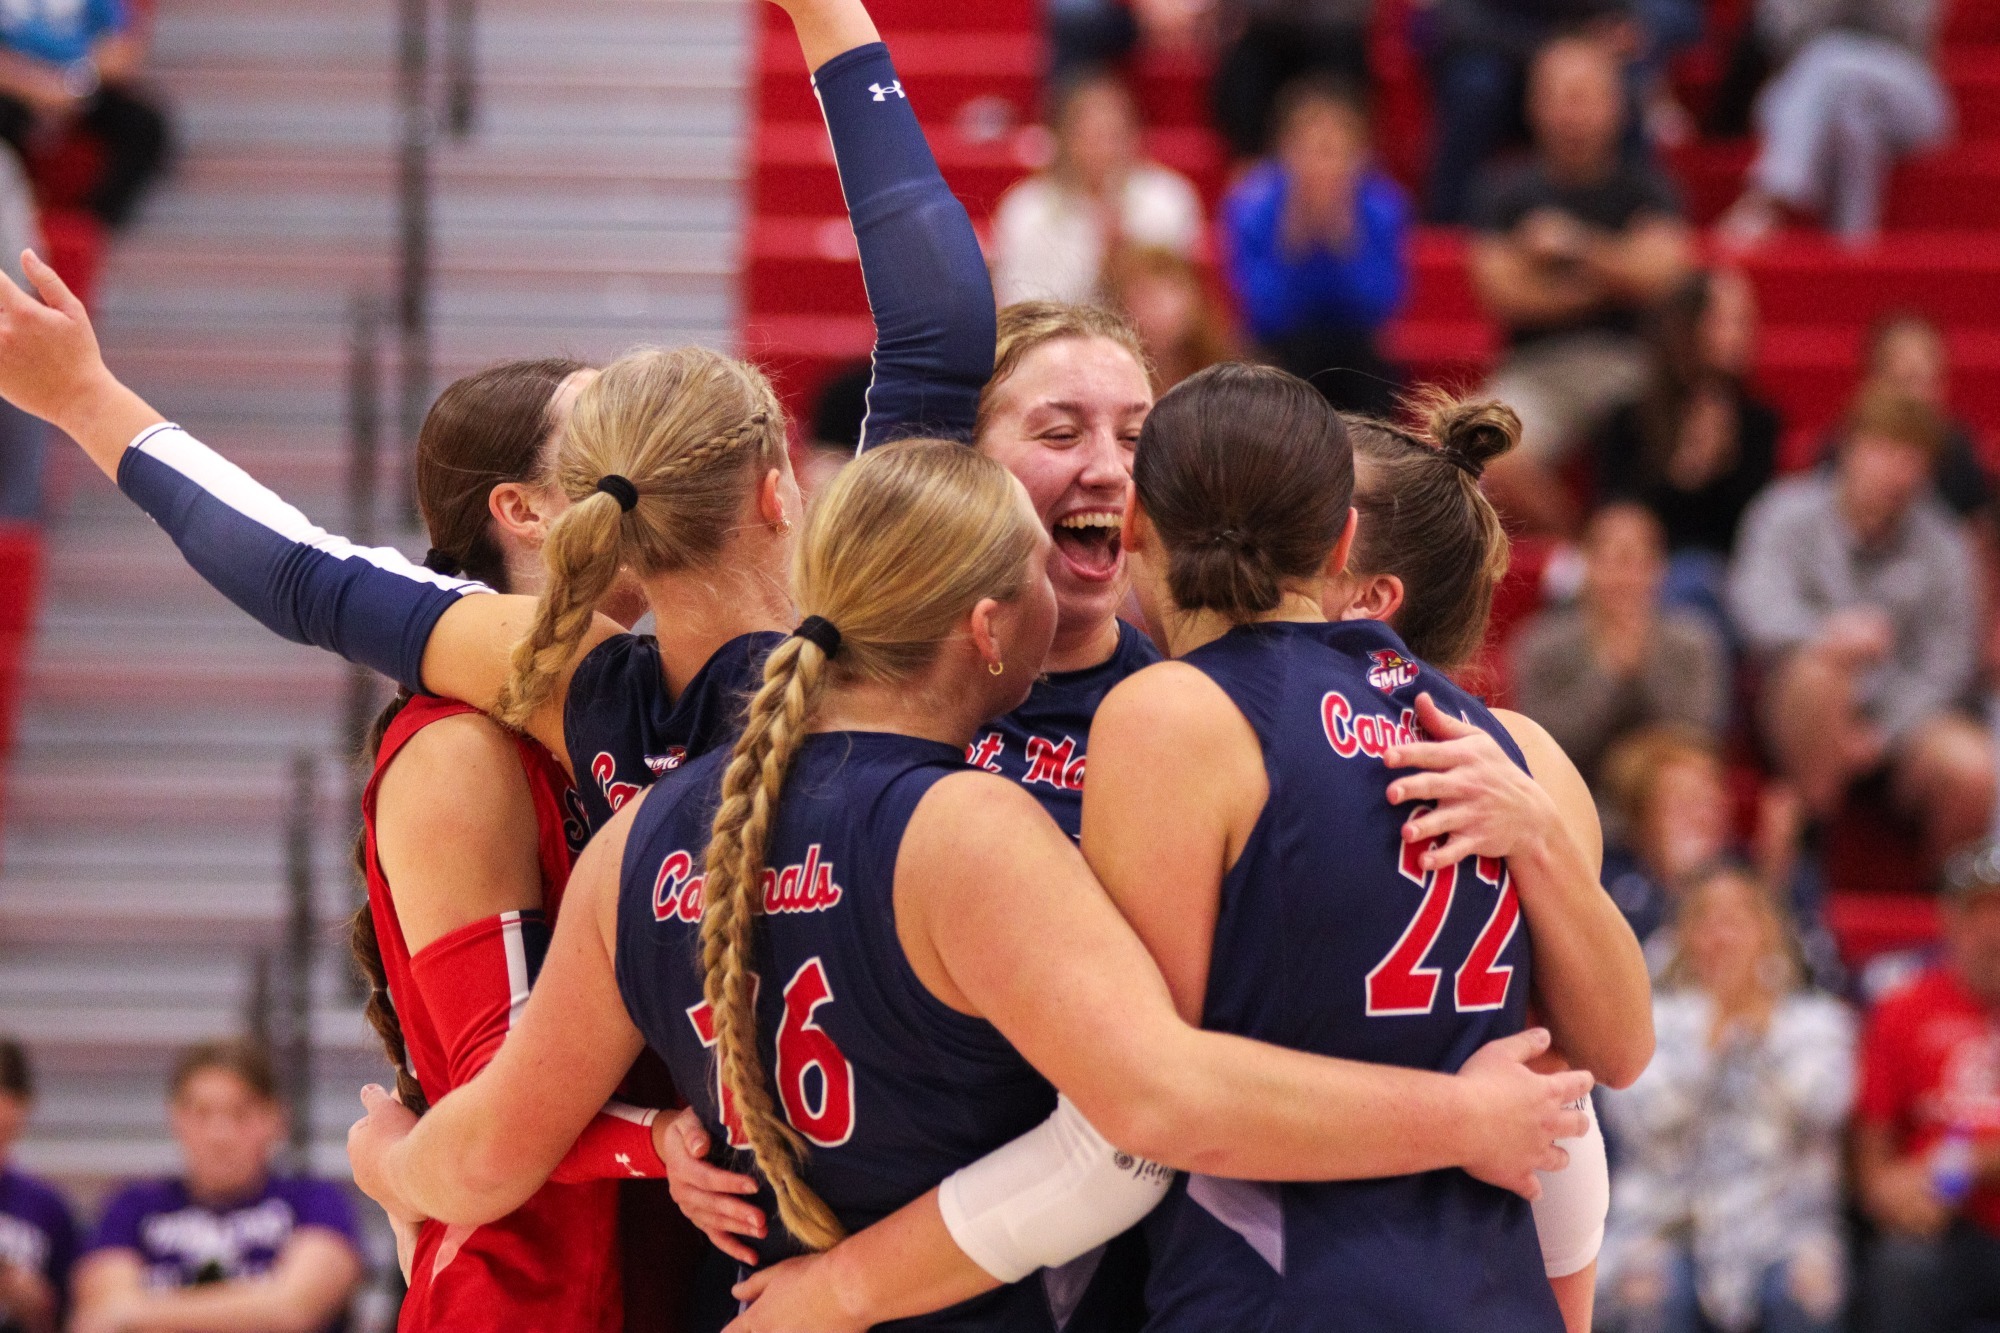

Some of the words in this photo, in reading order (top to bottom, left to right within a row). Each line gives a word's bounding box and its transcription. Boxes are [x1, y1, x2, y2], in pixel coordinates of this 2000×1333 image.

[653, 843, 843, 923] Canals
[1365, 805, 1519, 1016] 22
[686, 956, 855, 1150] 16
